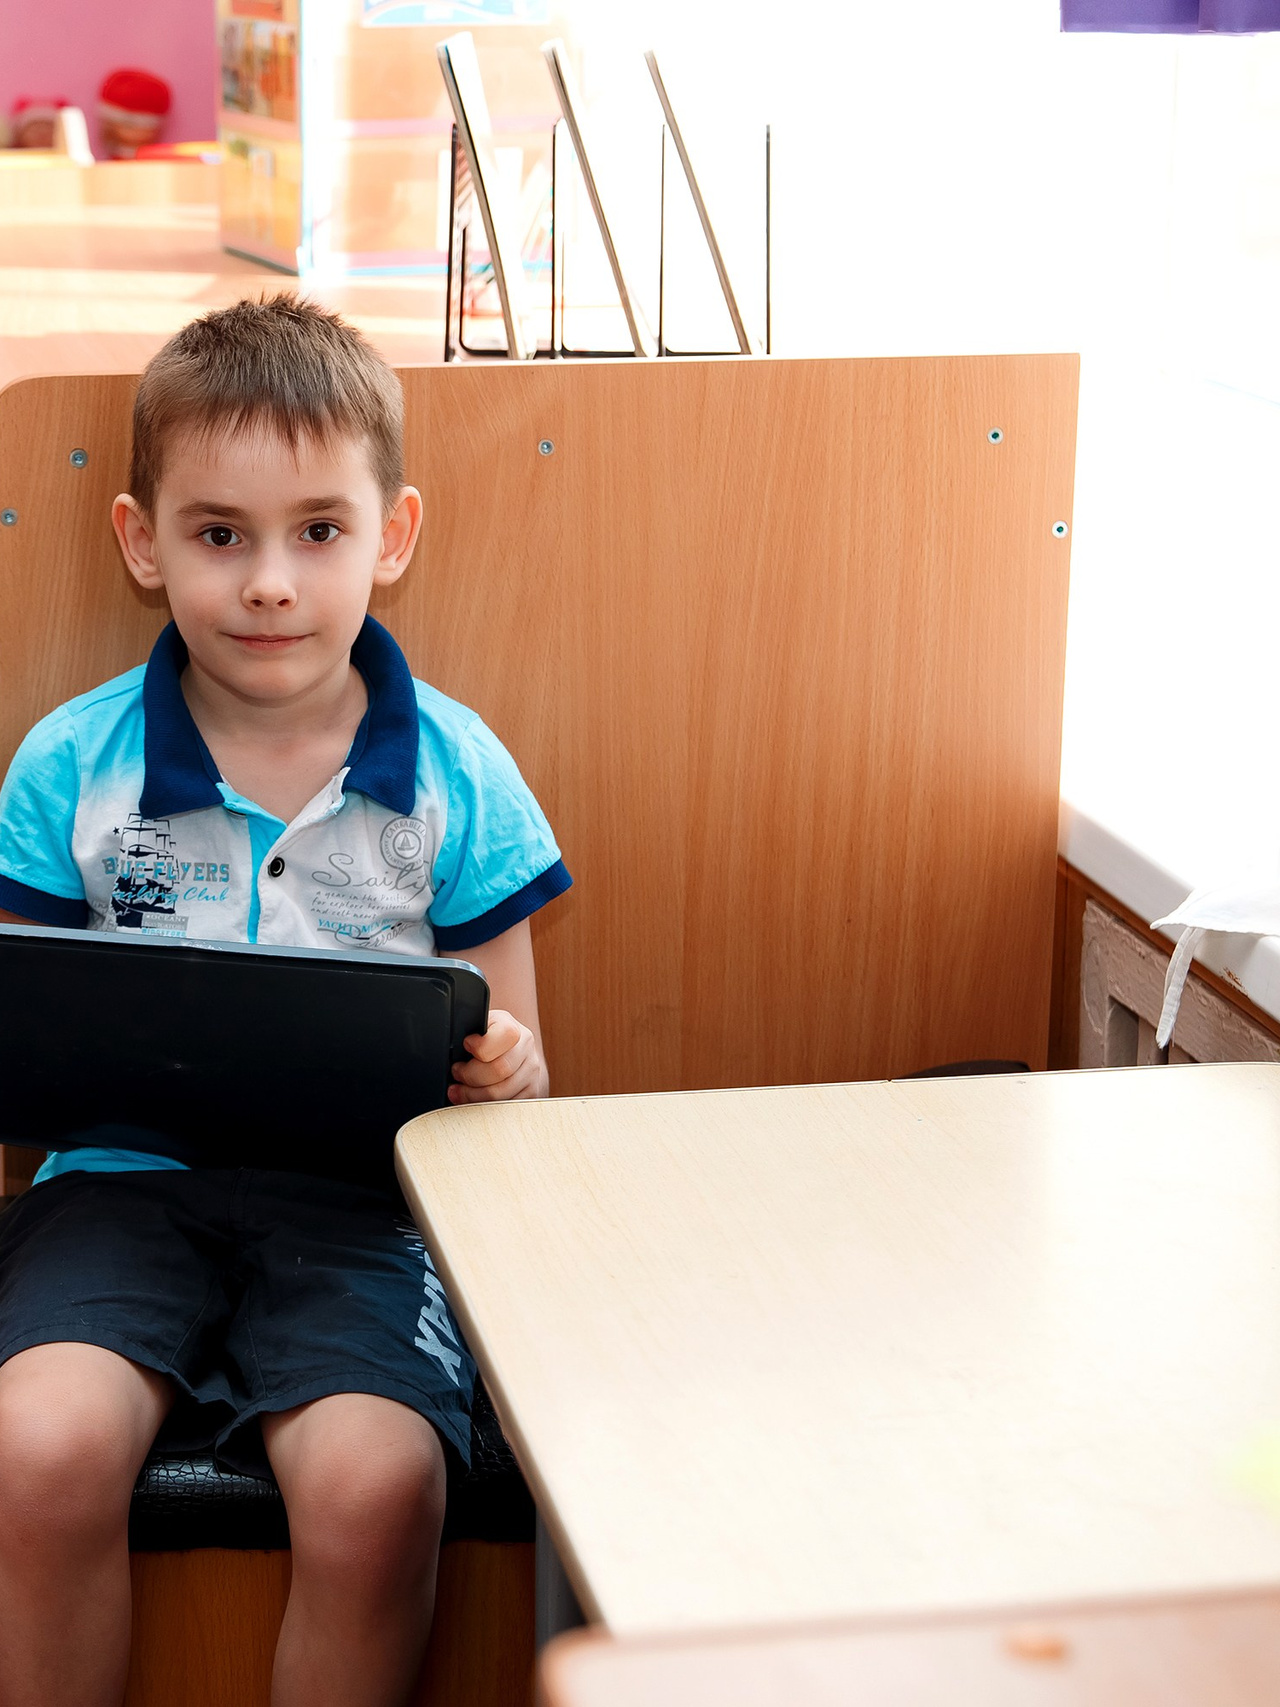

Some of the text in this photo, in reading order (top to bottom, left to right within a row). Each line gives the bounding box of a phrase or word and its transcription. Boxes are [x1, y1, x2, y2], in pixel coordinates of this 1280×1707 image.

[102, 856, 231, 882] BUE FLYERS
[183, 886, 230, 902] Club
[363, 894, 378, 902] the
[312, 897, 326, 906] for
